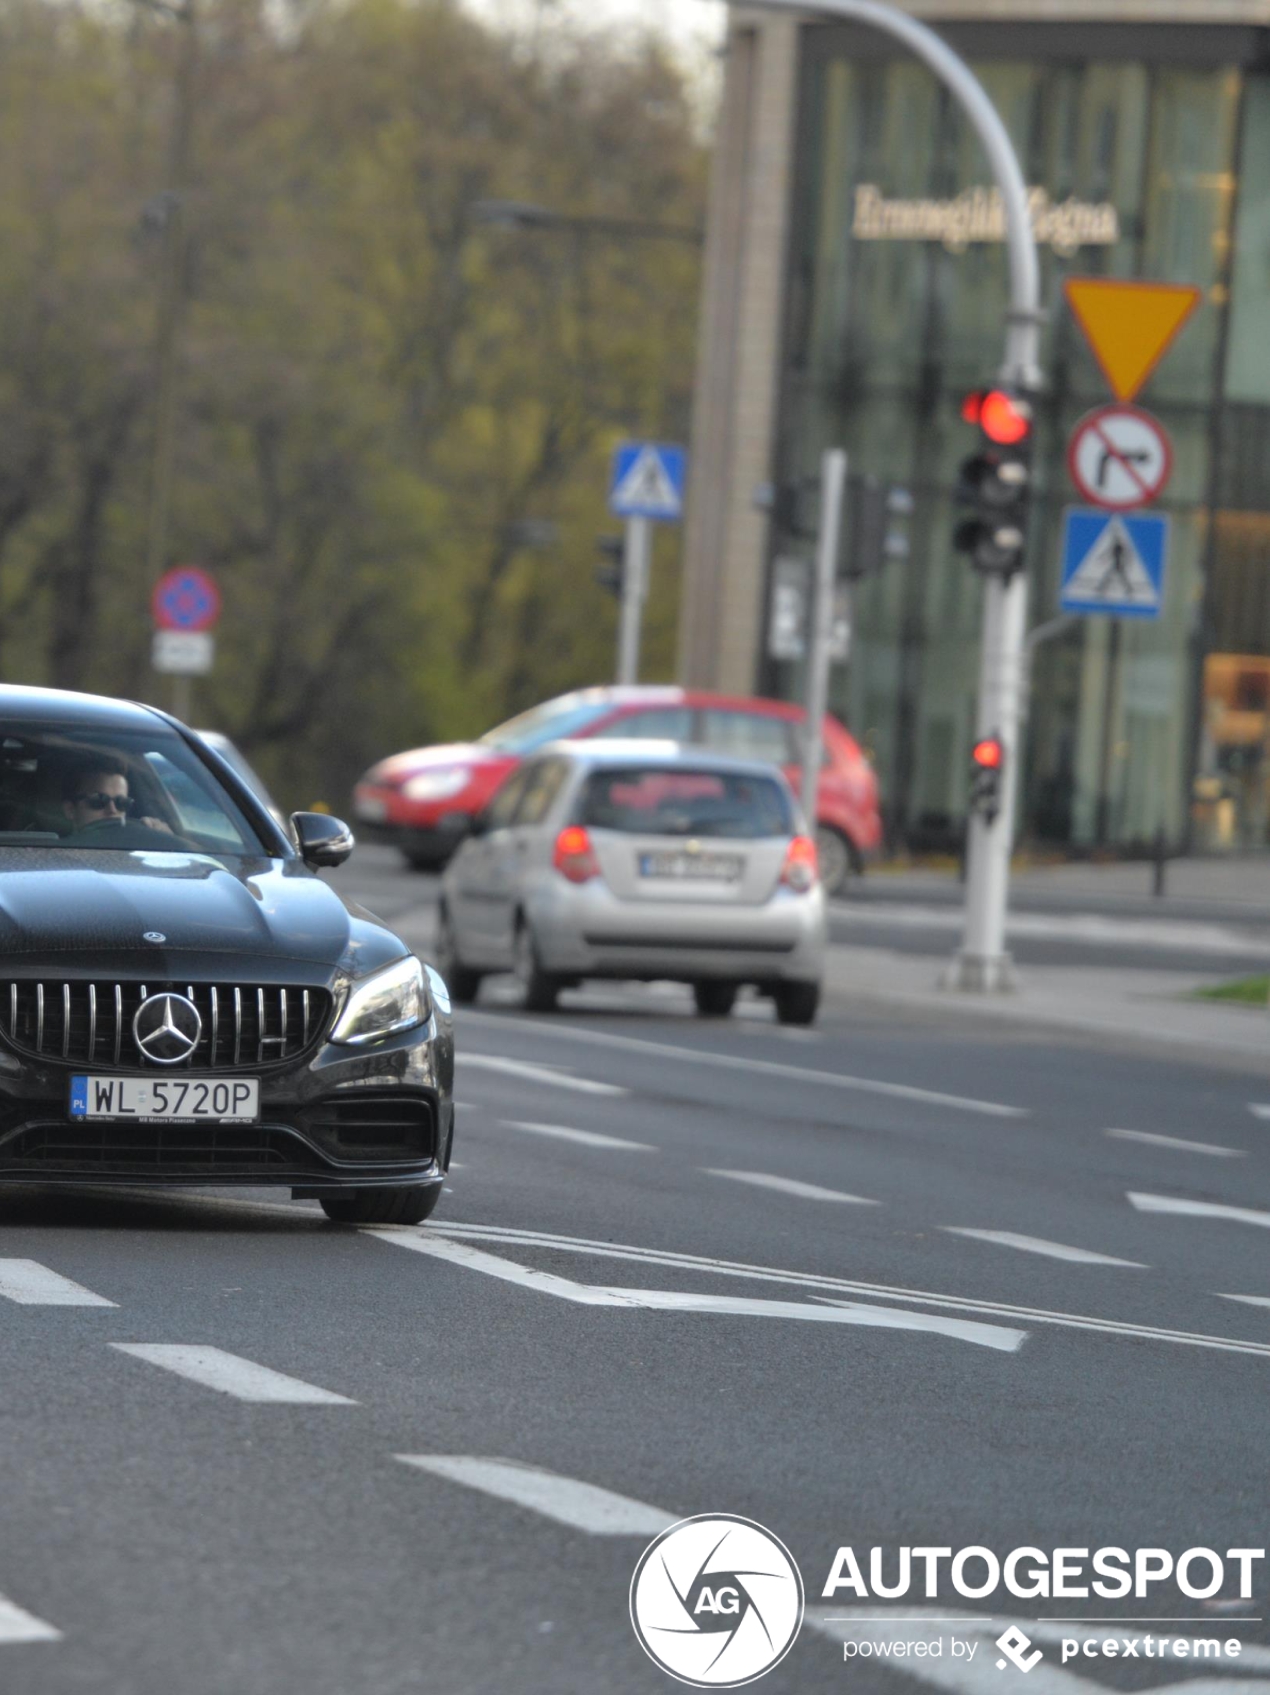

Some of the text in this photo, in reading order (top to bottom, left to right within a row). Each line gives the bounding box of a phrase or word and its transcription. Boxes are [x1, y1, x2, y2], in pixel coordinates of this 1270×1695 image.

[73, 1100, 85, 1109] PL
[95, 1081, 251, 1114] WL 5720P
